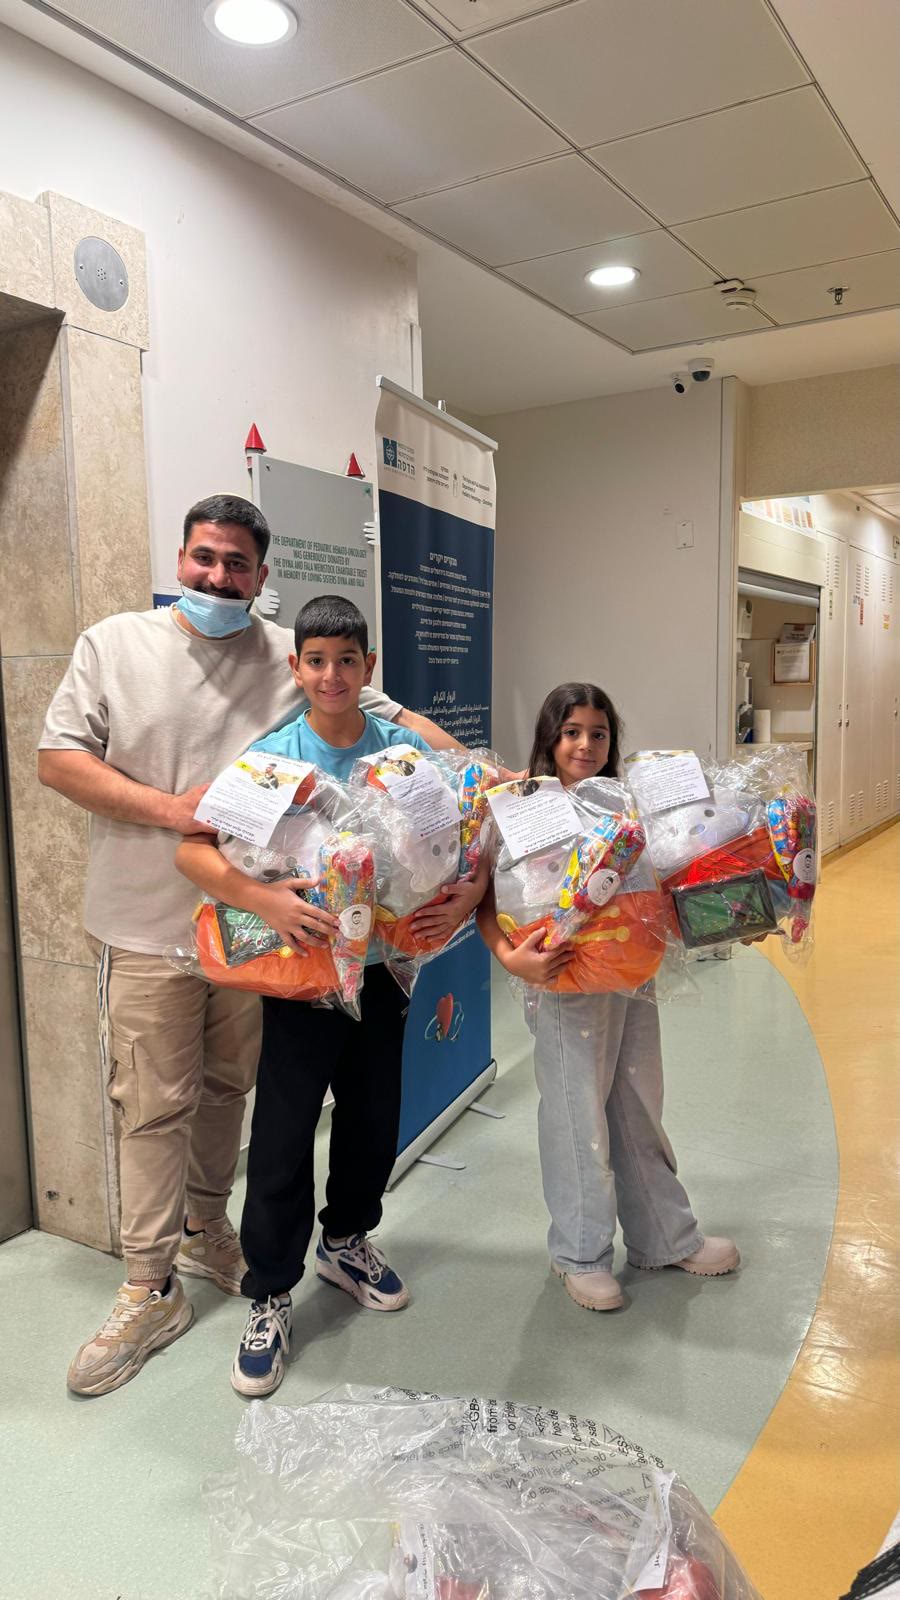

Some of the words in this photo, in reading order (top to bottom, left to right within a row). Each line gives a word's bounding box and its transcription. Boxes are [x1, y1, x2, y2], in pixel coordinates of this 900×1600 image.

[397, 460, 415, 476] הדסה
[272, 535, 281, 546] THE
[281, 536, 306, 549] DEPARTMENT
[307, 541, 313, 550] OF
[313, 541, 332, 553] PEDIATRIC
[293, 549, 303, 559] WAS
[303, 550, 327, 562] GENEROUSLY
[327, 554, 344, 565] DONATED
[345, 557, 350, 566] BY
[273, 557, 282, 567] THE
[282, 558, 293, 569] DYNA
[295, 559, 303, 570] AND
[335, 565, 356, 576] CHARITABLE
[357, 568, 367, 578] TRUST
[278, 568, 282, 578] IN
[283, 569, 301, 580] MEMORY
[301, 571, 307, 580] OF
[308, 572, 322, 583] LOVING
[323, 574, 337, 585] SISTERS
[337, 576, 347, 585] DYNA
[348, 577, 356, 586] AND
[469, 1398, 480, 1431] <GB>
[487, 1408, 498, 1433] from
[508, 1419, 516, 1431] or
